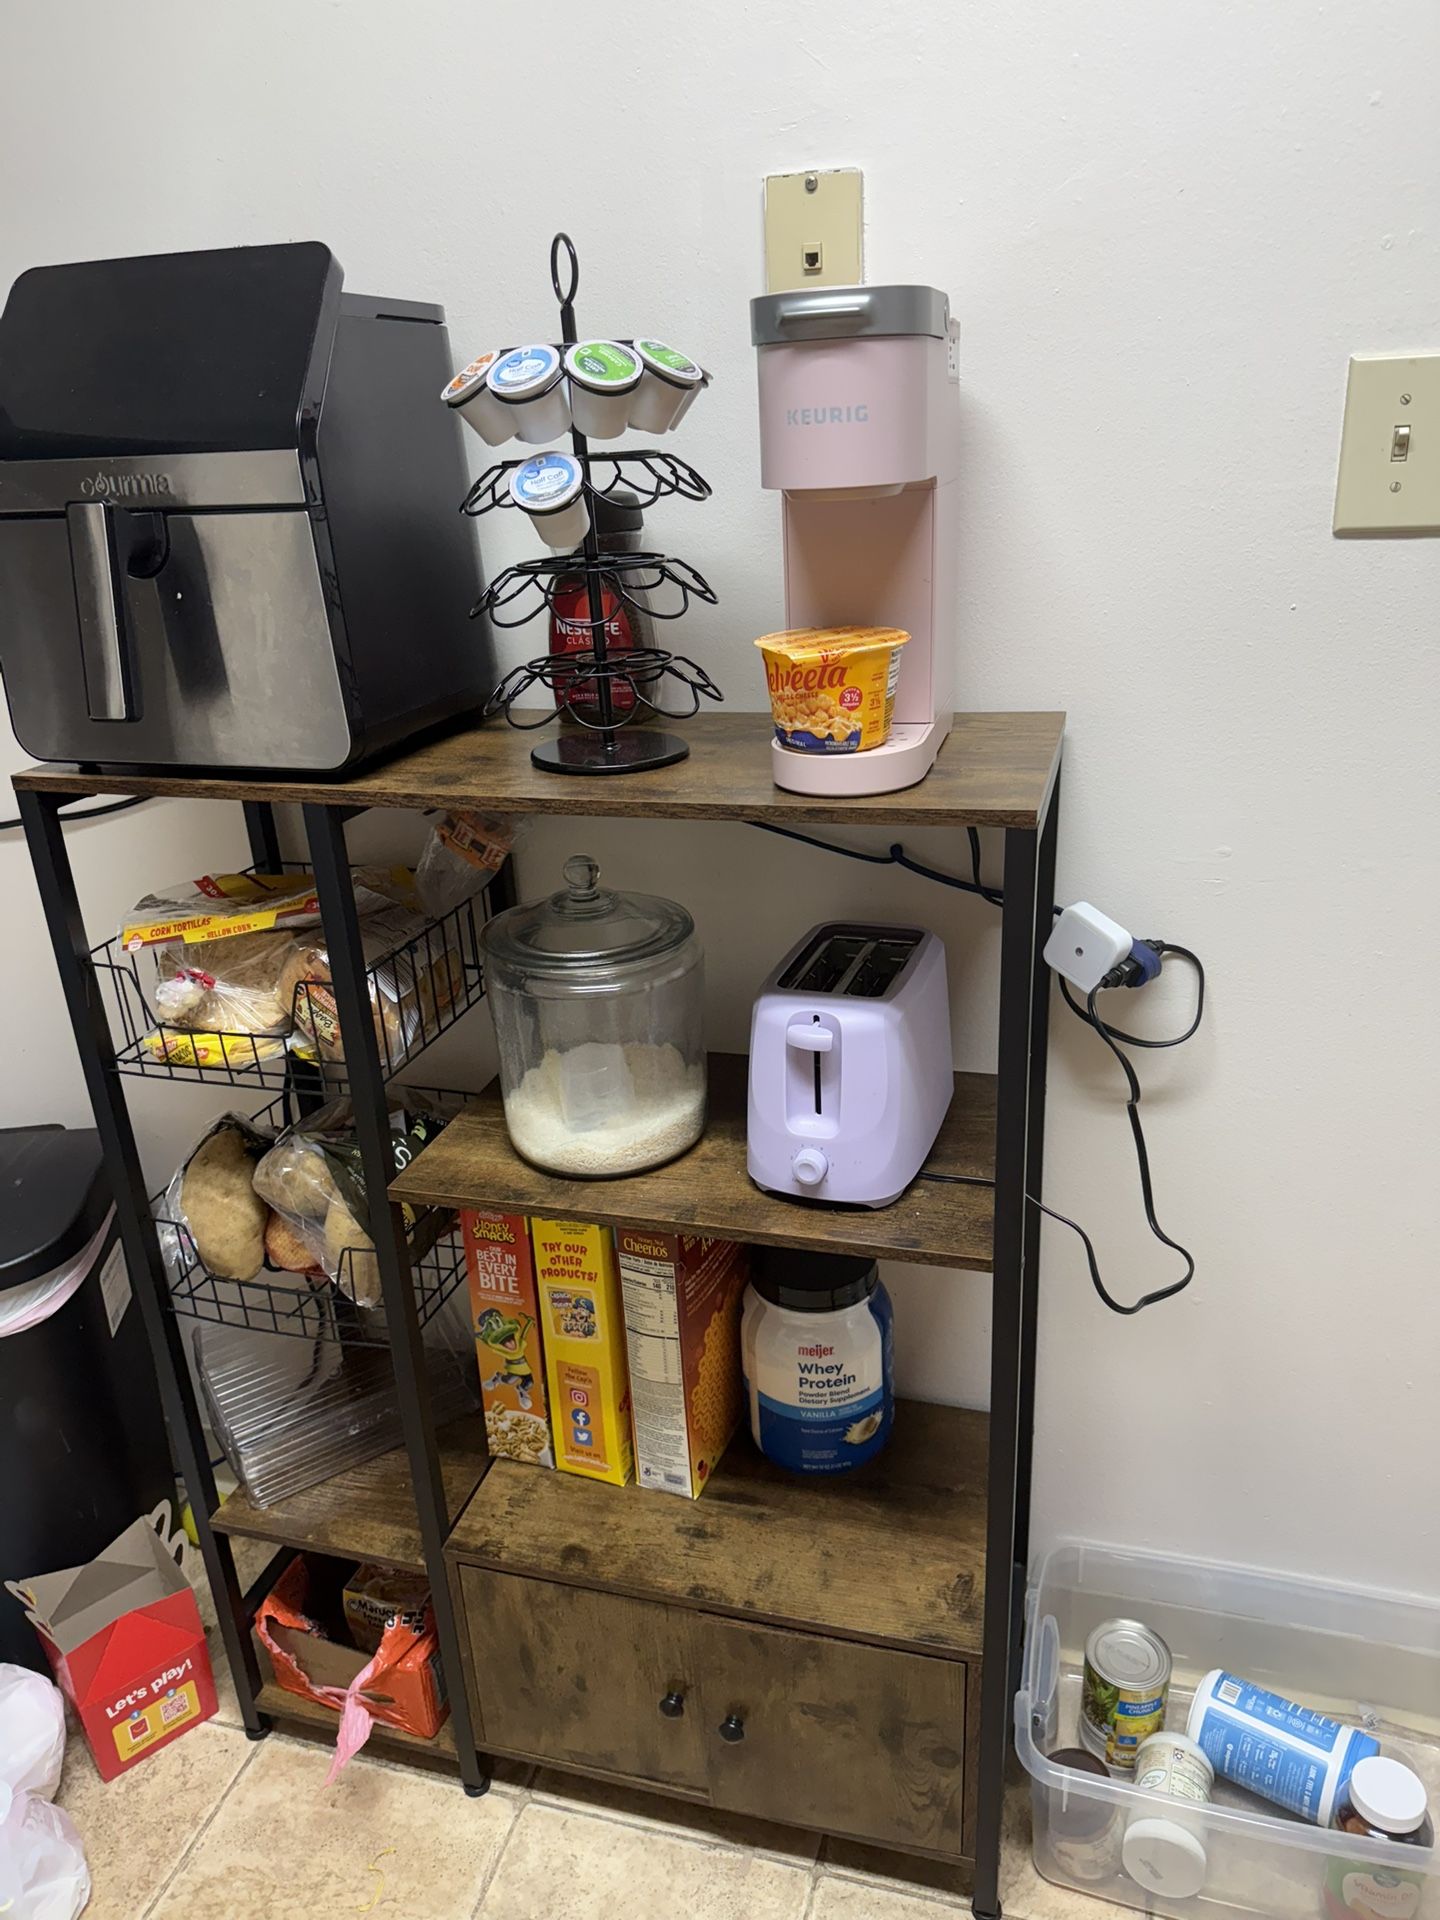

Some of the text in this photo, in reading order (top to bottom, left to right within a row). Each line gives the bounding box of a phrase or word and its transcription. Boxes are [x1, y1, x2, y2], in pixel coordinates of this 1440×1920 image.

[786, 405, 869, 426] KEURIG
[530, 476, 546, 486] Half
[769, 661, 848, 692] elveeta
[150, 917, 212, 938] CORN TORTILLAS
[206, 923, 252, 939] YELLOW CORN
[541, 1242, 588, 1256] TRY OUR
[623, 1237, 669, 1258] Cheerios
[476, 1249, 517, 1265] BEST IN
[550, 1255, 583, 1267] OTHER
[478, 1261, 517, 1277] EVERY
[540, 1267, 598, 1283] PRODUCTS!
[480, 1272, 520, 1294] BITE
[798, 1345, 835, 1359] meijer
[798, 1362, 844, 1376] Whey
[798, 1374, 857, 1390] Protein
[799, 1386, 871, 1405] Dietary Supplement
[829, 1388, 850, 1397] Blend
[800, 1410, 837, 1418] VANILLA
[105, 1658, 193, 1719] Let's play!
